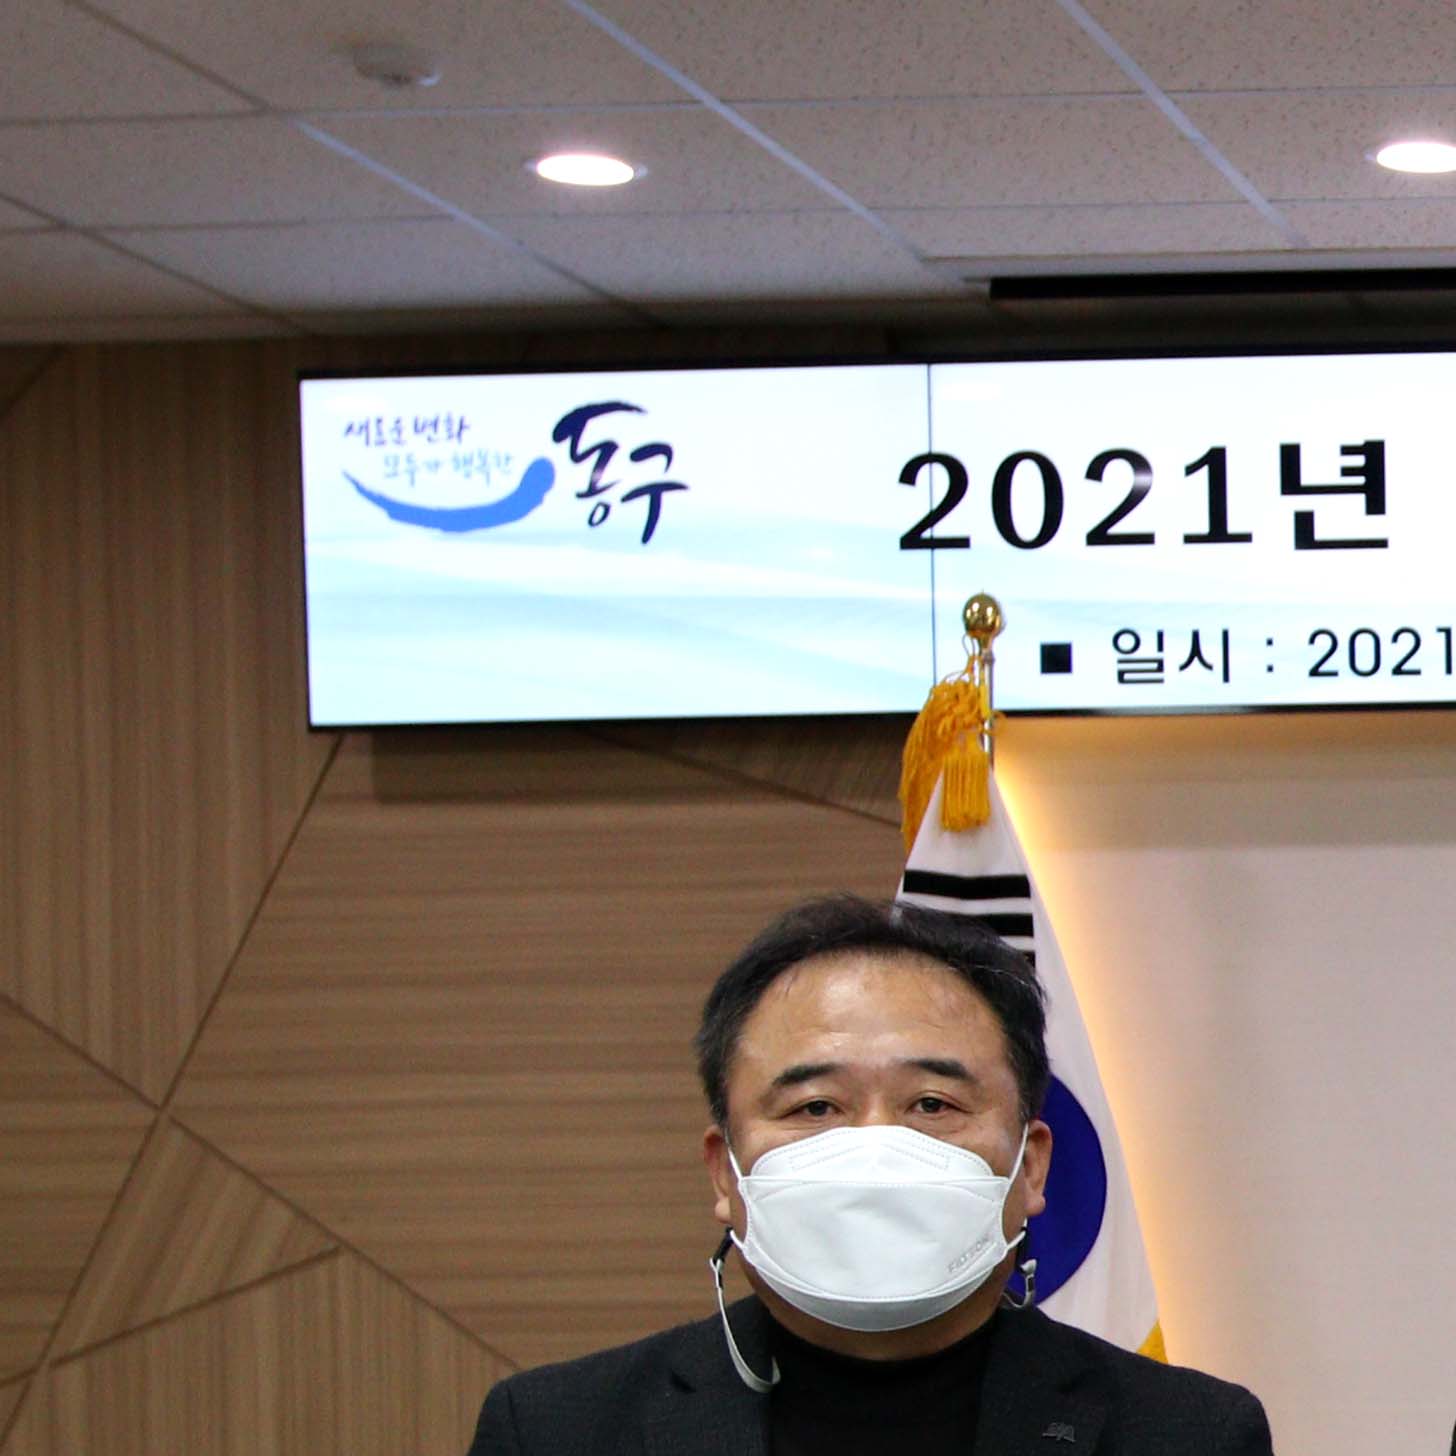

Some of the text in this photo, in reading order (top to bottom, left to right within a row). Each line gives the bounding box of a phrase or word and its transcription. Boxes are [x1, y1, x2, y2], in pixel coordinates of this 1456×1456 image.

[344, 412, 470, 447] 새로운 변화
[552, 399, 689, 545] 동구
[897, 438, 1390, 552] 2021년
[1111, 626, 1231, 685] 일시
